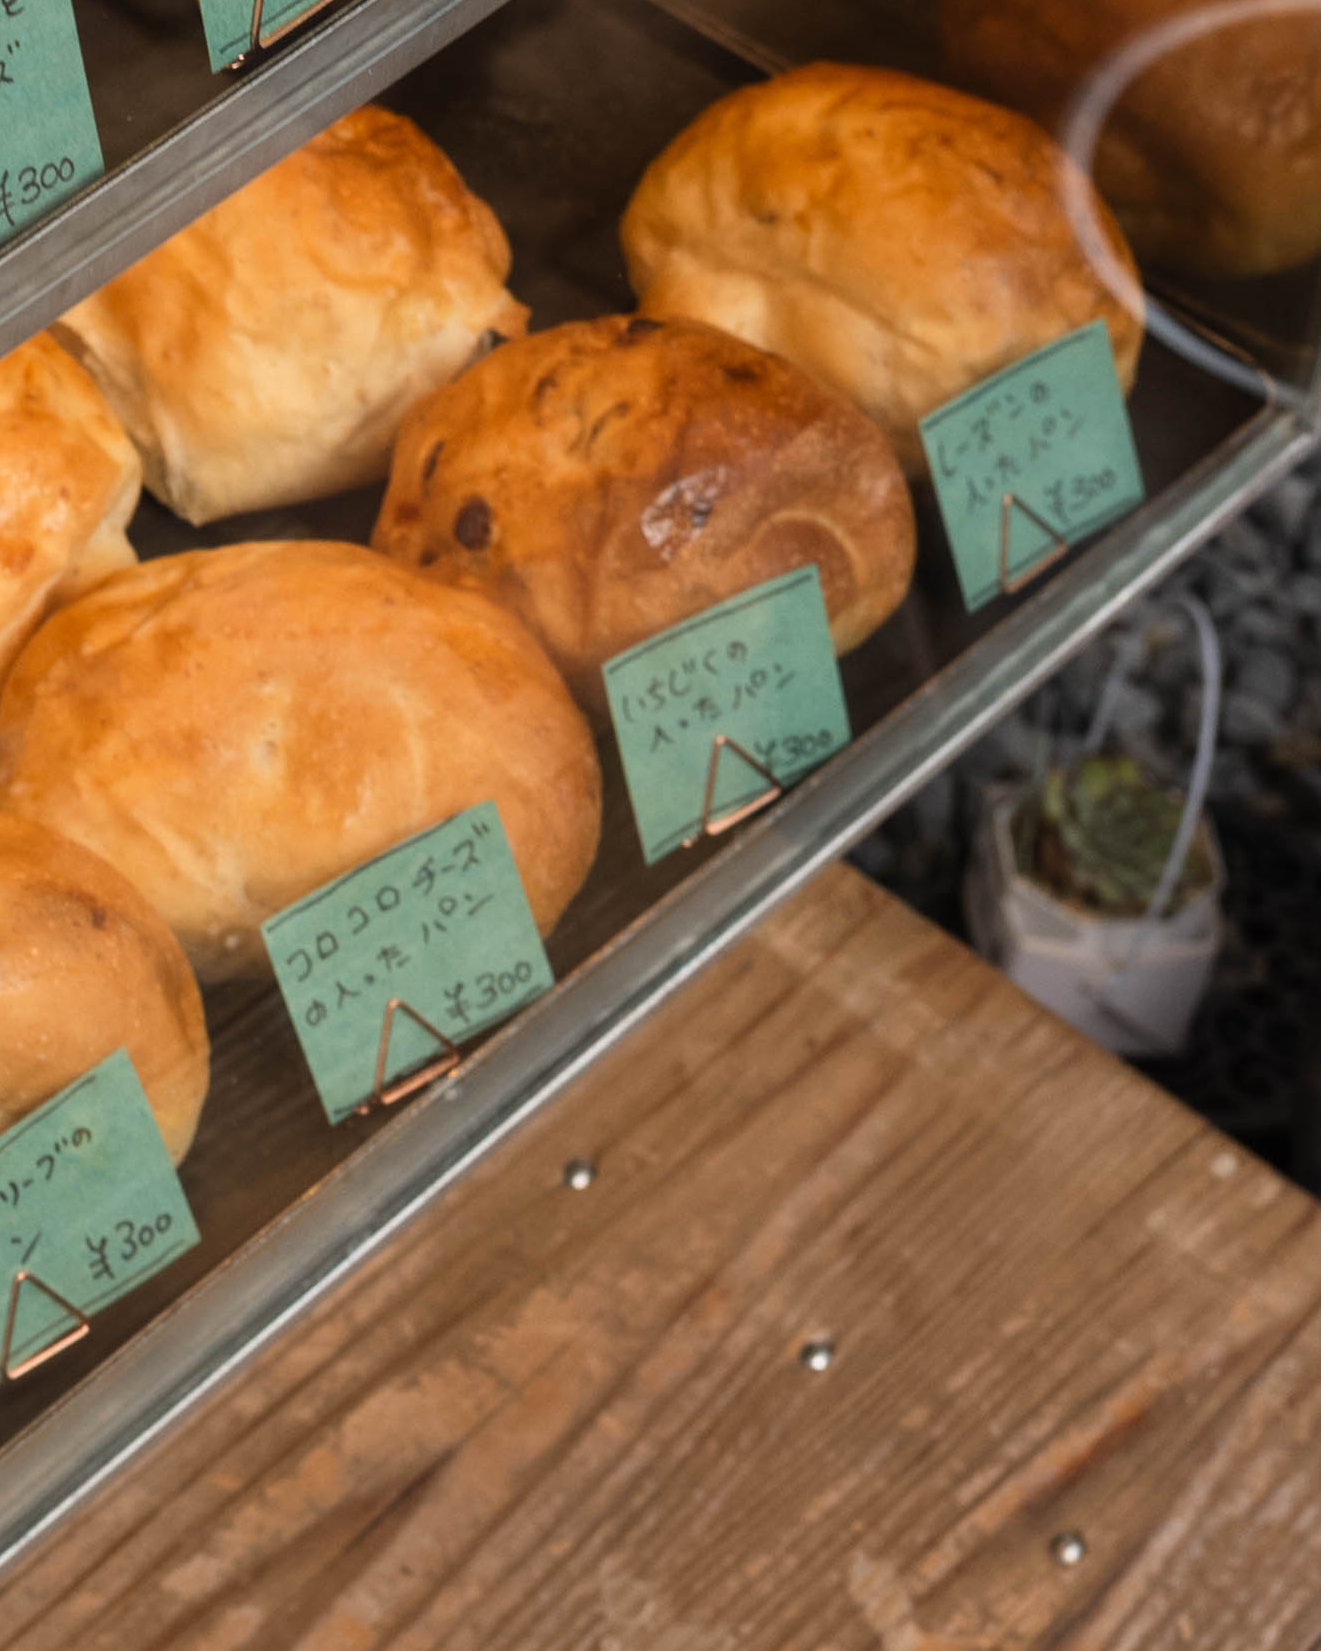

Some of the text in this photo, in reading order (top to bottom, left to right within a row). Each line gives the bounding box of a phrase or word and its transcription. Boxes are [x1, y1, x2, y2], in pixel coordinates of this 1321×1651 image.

[286, 821, 490, 982] コロコロチーズ
[444, 961, 533, 1025] ¥300
[86, 1212, 172, 1280] ¥300
